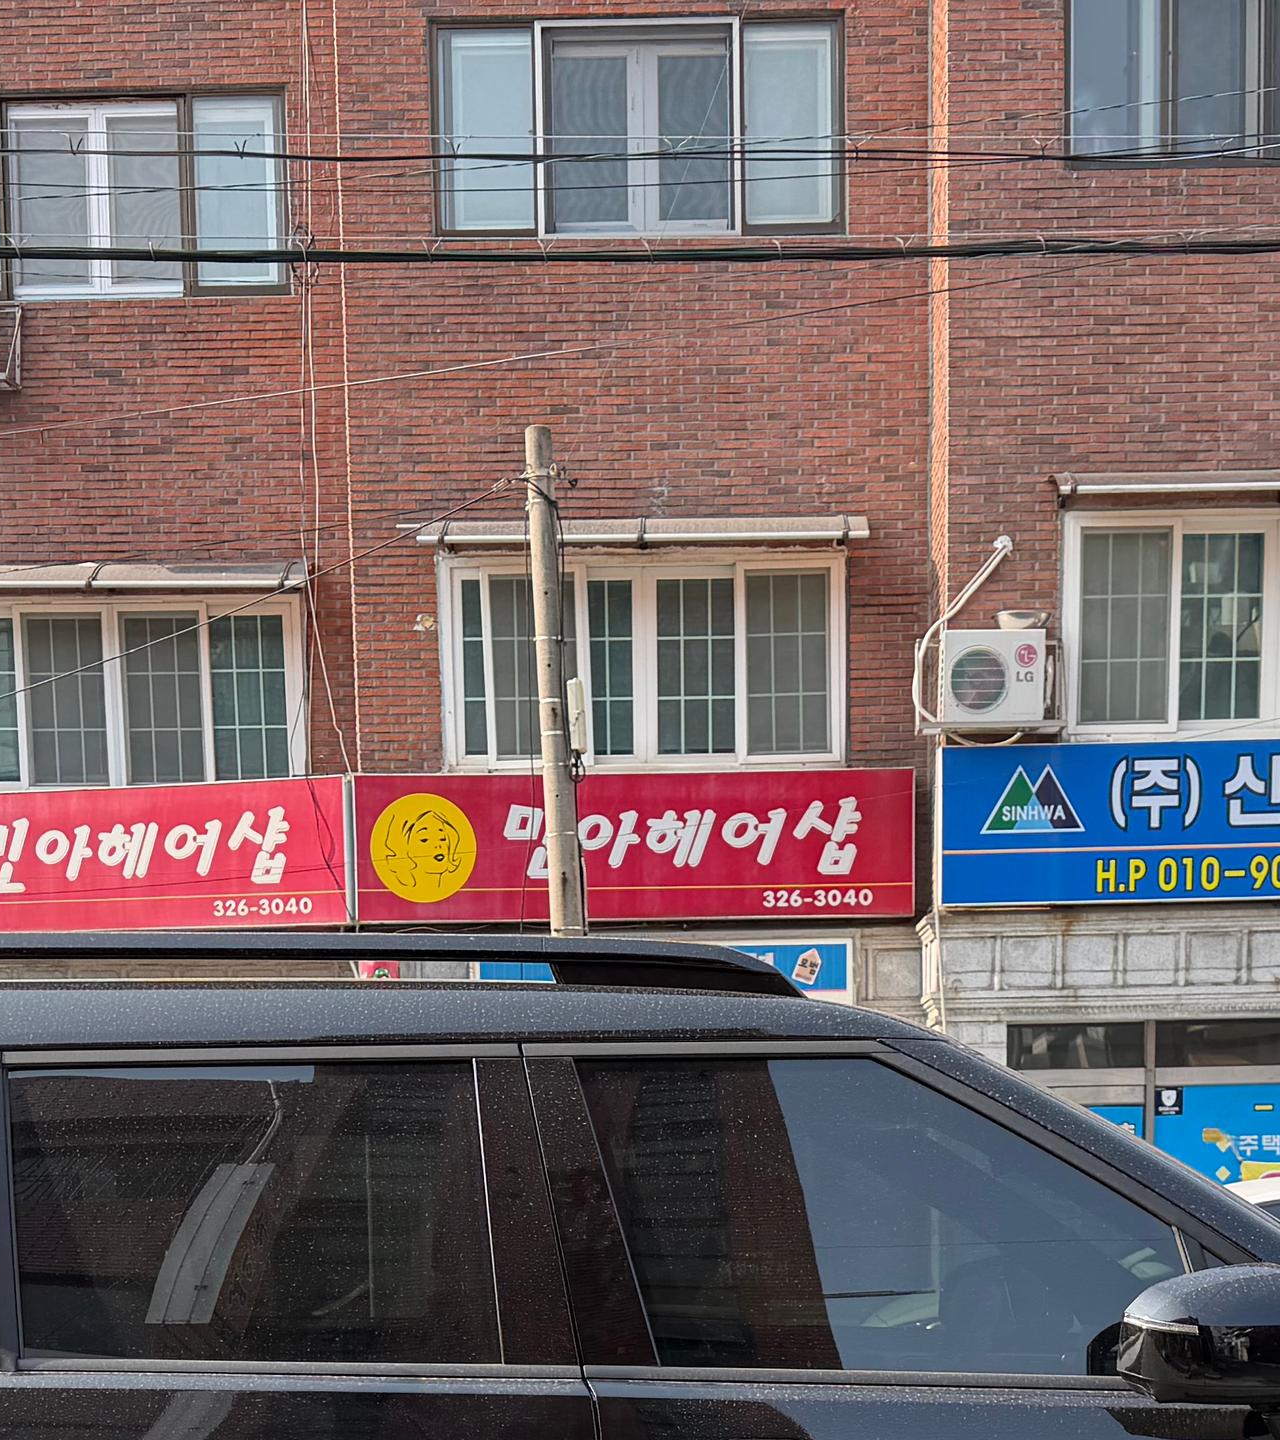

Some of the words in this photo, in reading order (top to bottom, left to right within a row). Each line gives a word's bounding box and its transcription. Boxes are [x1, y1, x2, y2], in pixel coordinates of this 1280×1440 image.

[1015, 671, 1034, 682] LG
[1001, 803, 1067, 823] SINHWA
[1096, 857, 1146, 893] H.P
[213, 896, 313, 918] 326-3040
[762, 888, 874, 908] 326-3040
